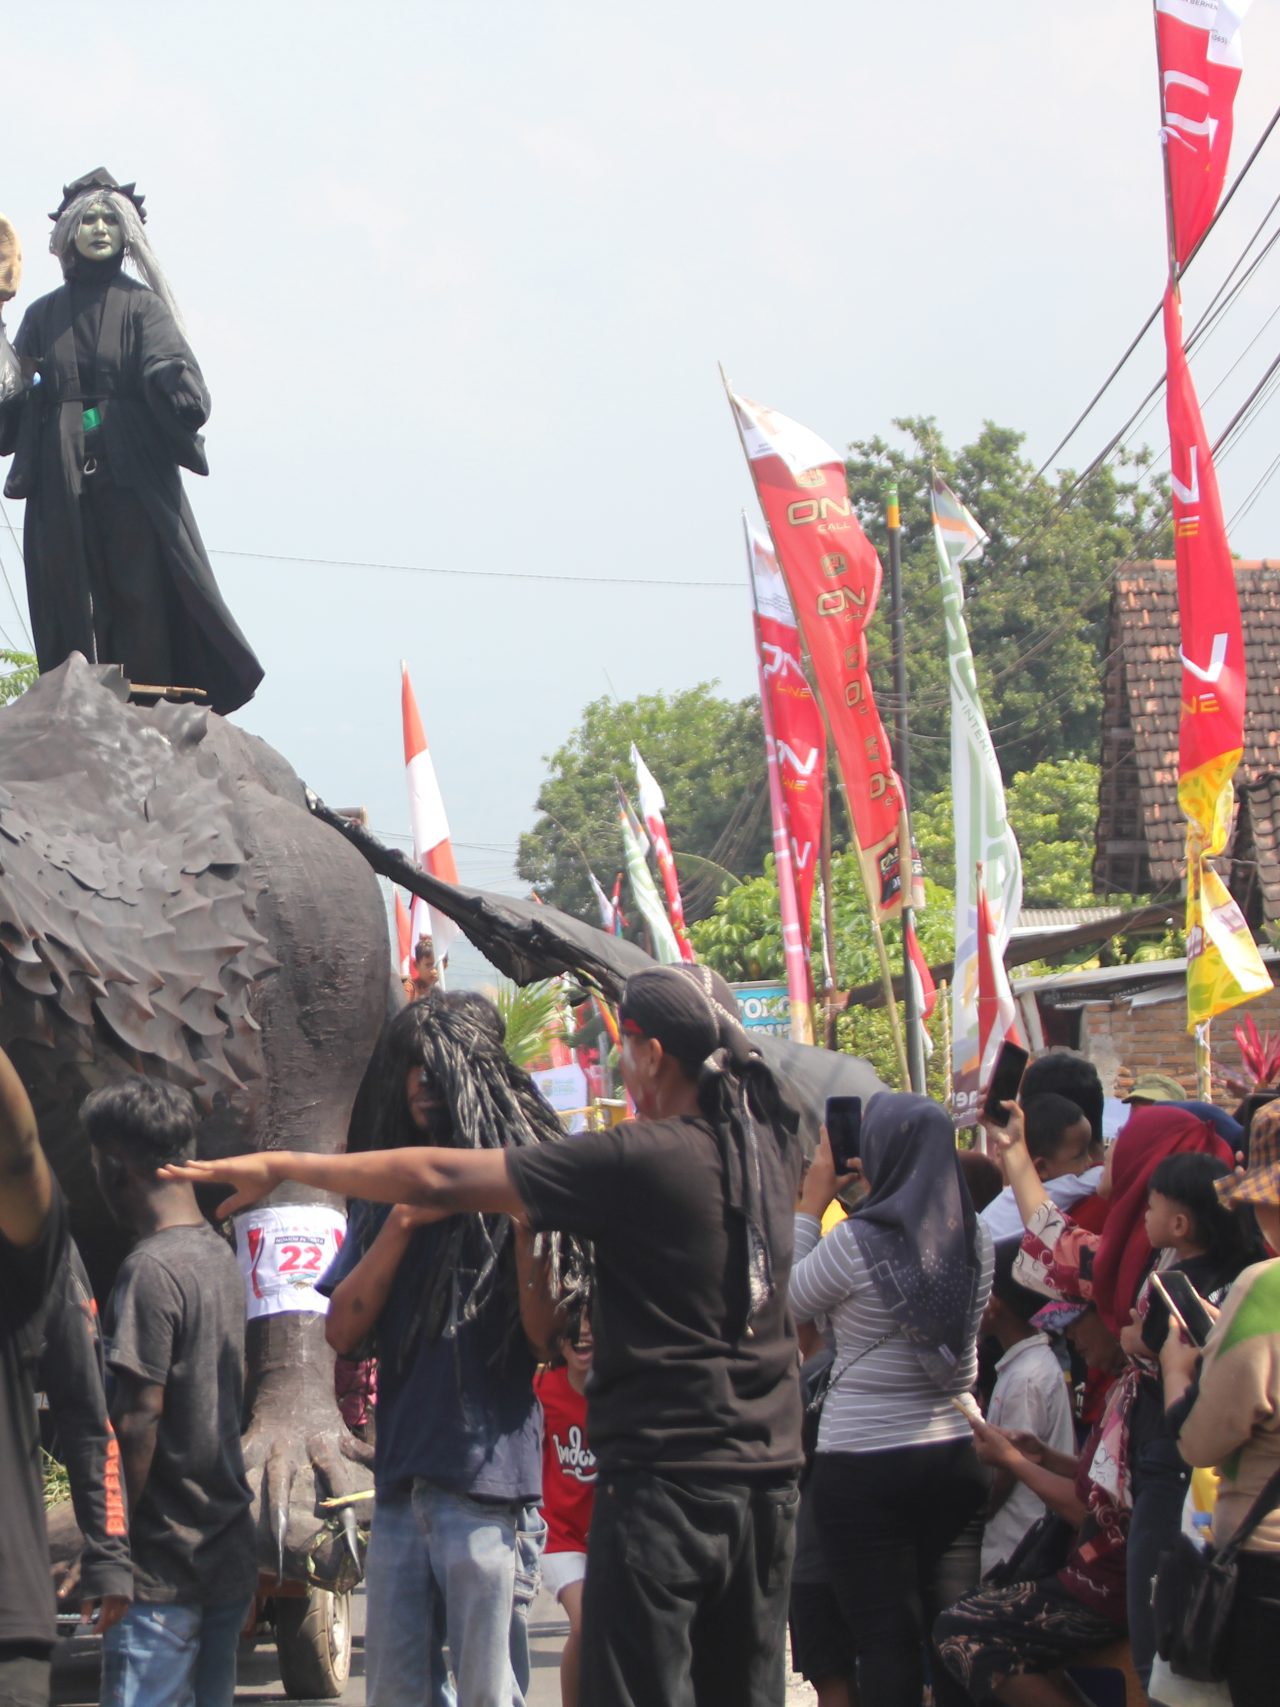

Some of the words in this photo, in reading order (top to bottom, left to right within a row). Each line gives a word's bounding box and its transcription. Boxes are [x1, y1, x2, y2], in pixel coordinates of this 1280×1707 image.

[787, 496, 852, 527] ON
[817, 522, 851, 534] CALL
[816, 586, 866, 616] ON
[278, 1245, 323, 1272] 22
